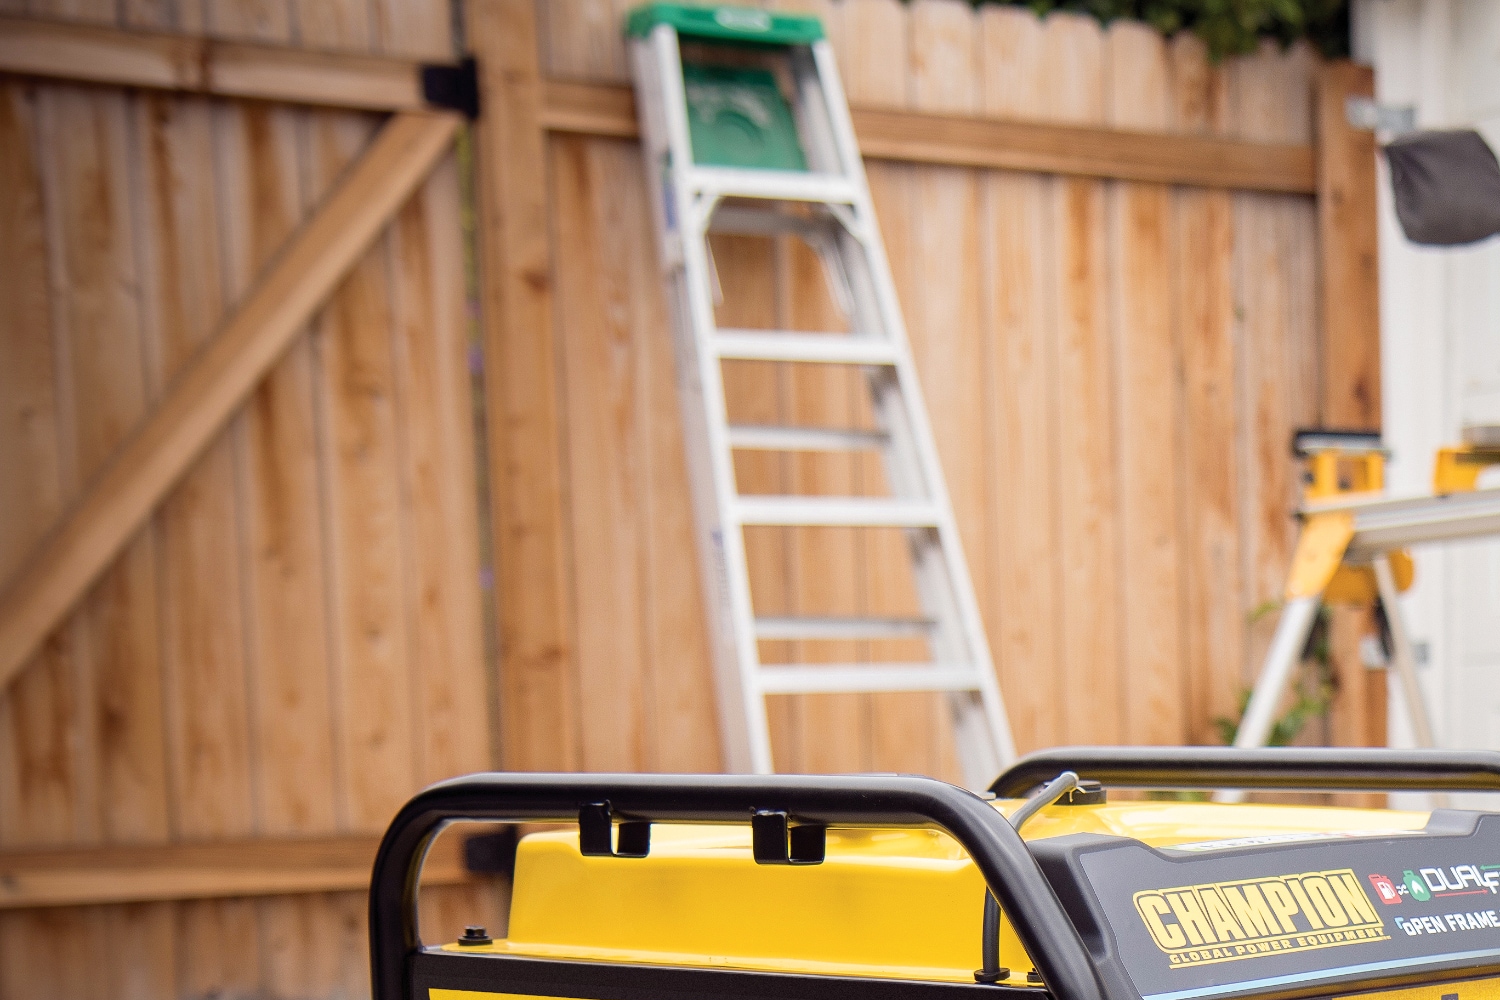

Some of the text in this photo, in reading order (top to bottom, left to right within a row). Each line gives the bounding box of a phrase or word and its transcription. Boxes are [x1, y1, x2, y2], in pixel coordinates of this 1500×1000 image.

[1419, 865, 1486, 892] DUAL
[1136, 871, 1381, 951] CHAMPION
[1169, 927, 1385, 964] GLOBAL POWER EQUIPMENT
